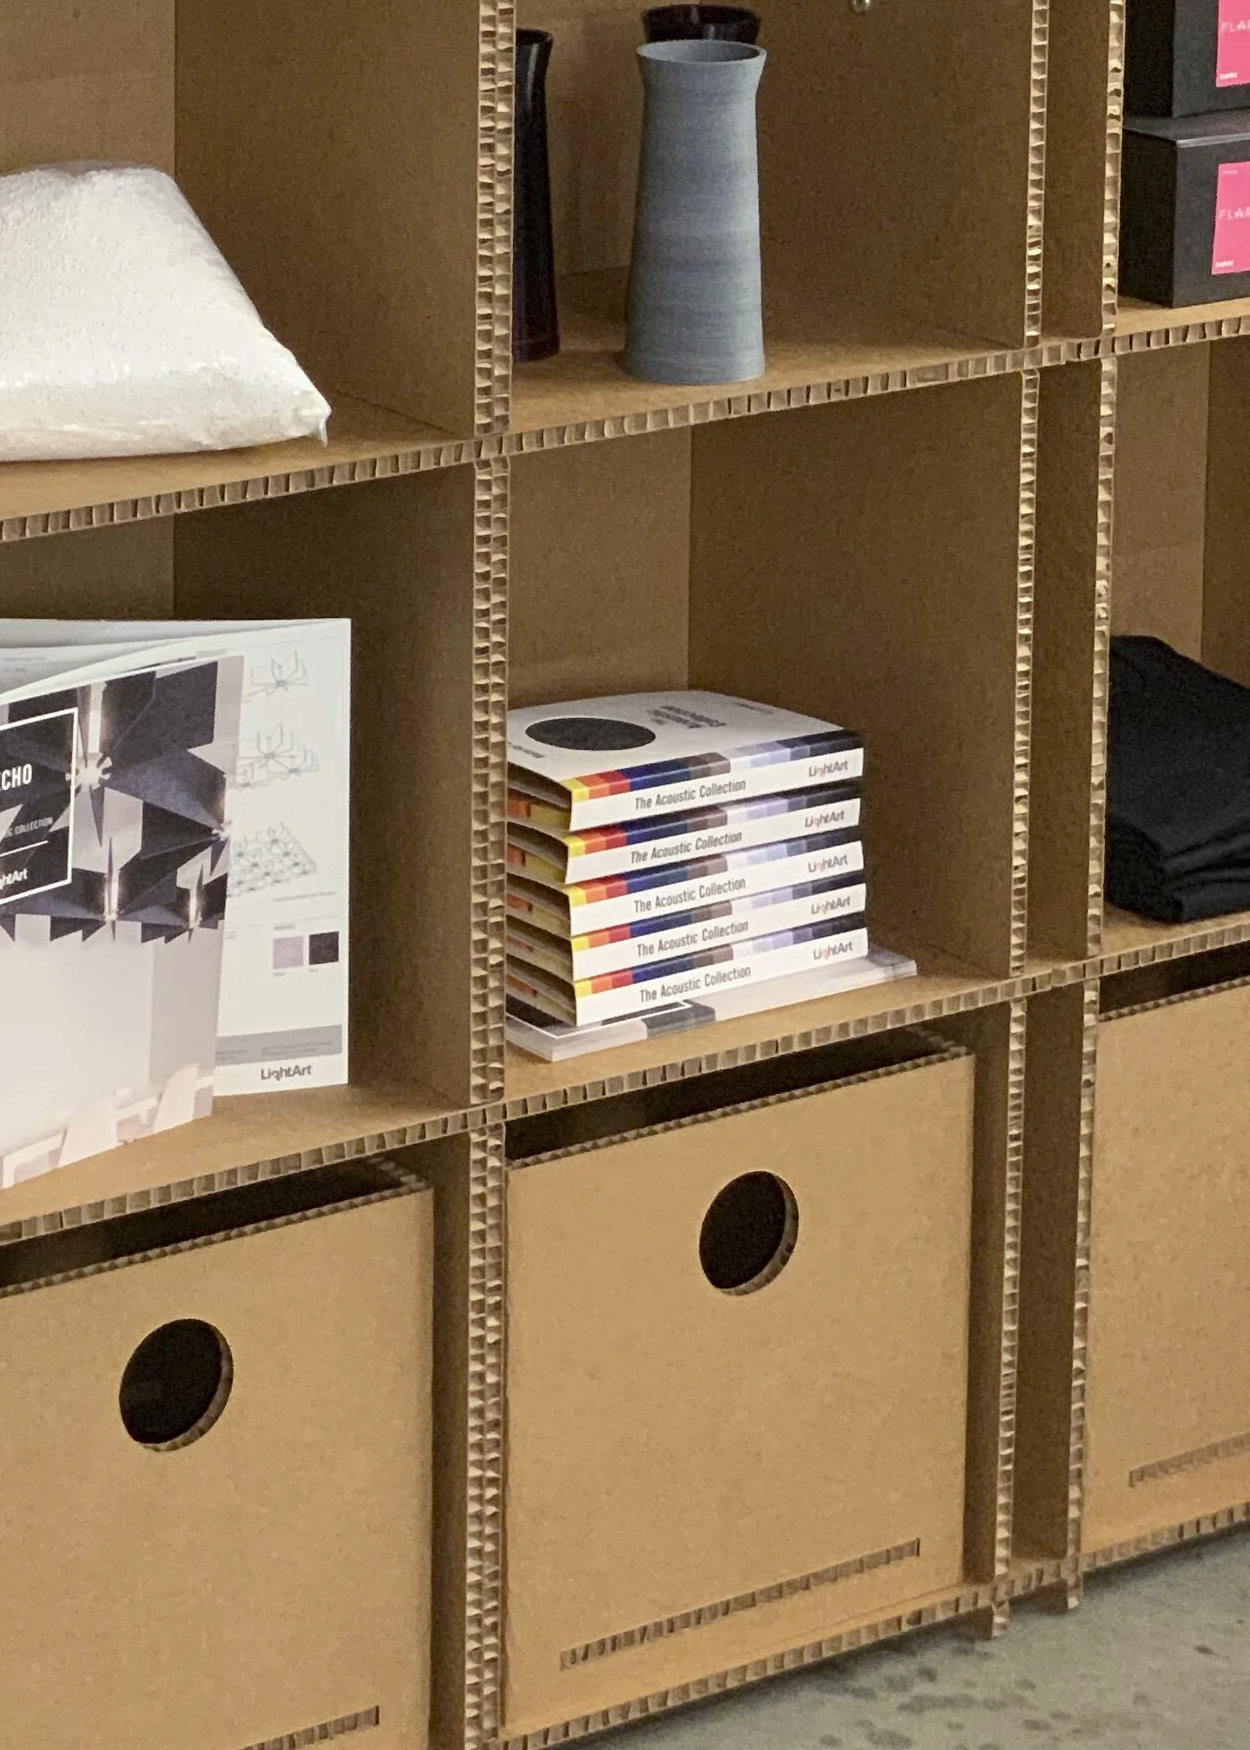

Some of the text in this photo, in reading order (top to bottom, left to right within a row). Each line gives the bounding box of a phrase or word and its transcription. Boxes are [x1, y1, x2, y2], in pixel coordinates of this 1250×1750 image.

[808, 760, 850, 777] LightArt
[634, 779, 747, 810] The Acoustic Collection
[14, 817, 53, 835] COLLECTION
[804, 810, 846, 828] LightArt
[630, 831, 743, 864] The Acoustic Collection
[808, 854, 849, 873] LightArt
[634, 877, 747, 914] The Acoustic Collection
[811, 896, 851, 915] LightArt
[637, 921, 749, 957] The Acoustic Collection
[813, 941, 854, 960] LightArt
[640, 966, 752, 1003] The Acoustic Collection
[261, 1064, 312, 1081] LightArt
